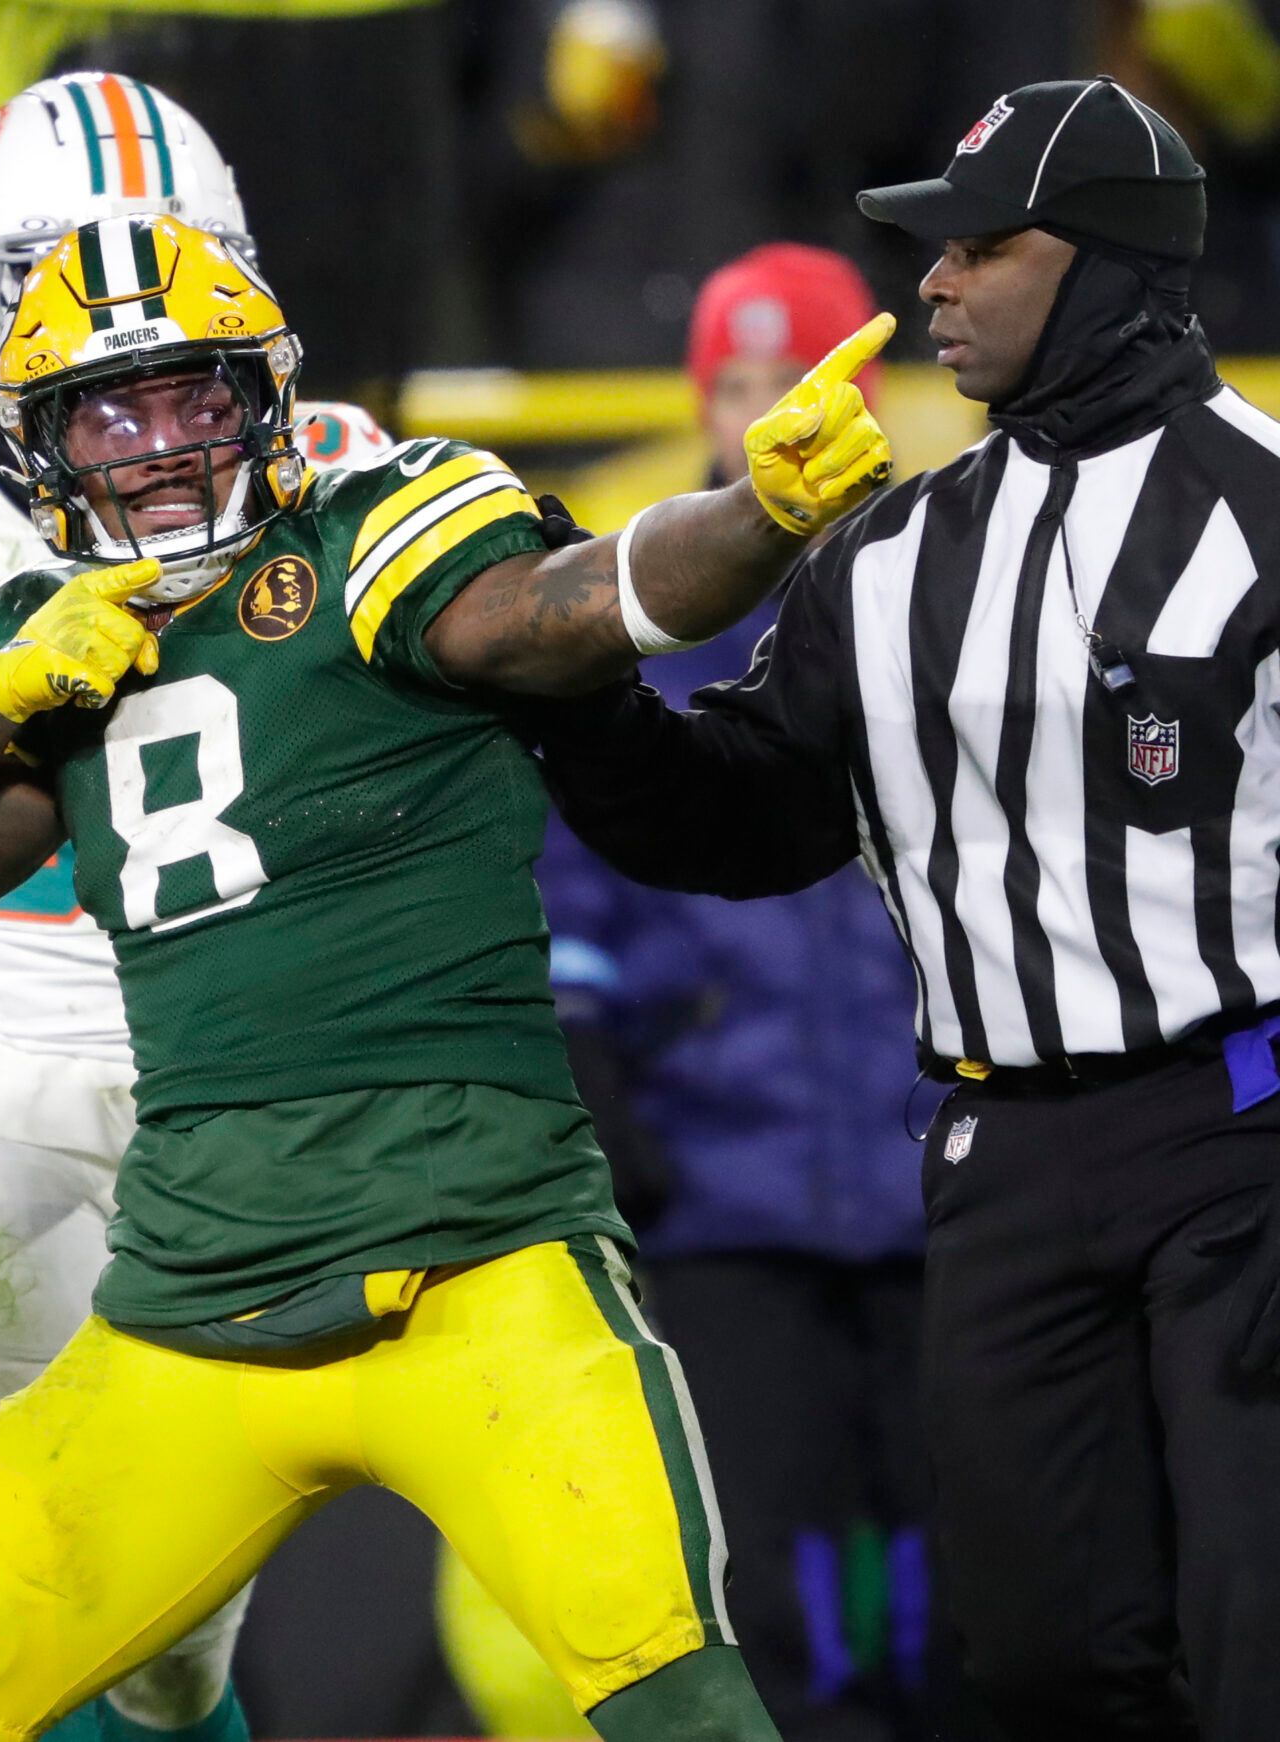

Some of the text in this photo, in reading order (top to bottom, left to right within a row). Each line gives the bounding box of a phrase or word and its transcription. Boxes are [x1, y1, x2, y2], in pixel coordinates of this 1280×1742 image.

[104, 327, 160, 350] PACKERS
[1131, 743, 1174, 776] NFL
[104, 673, 271, 933] 8
